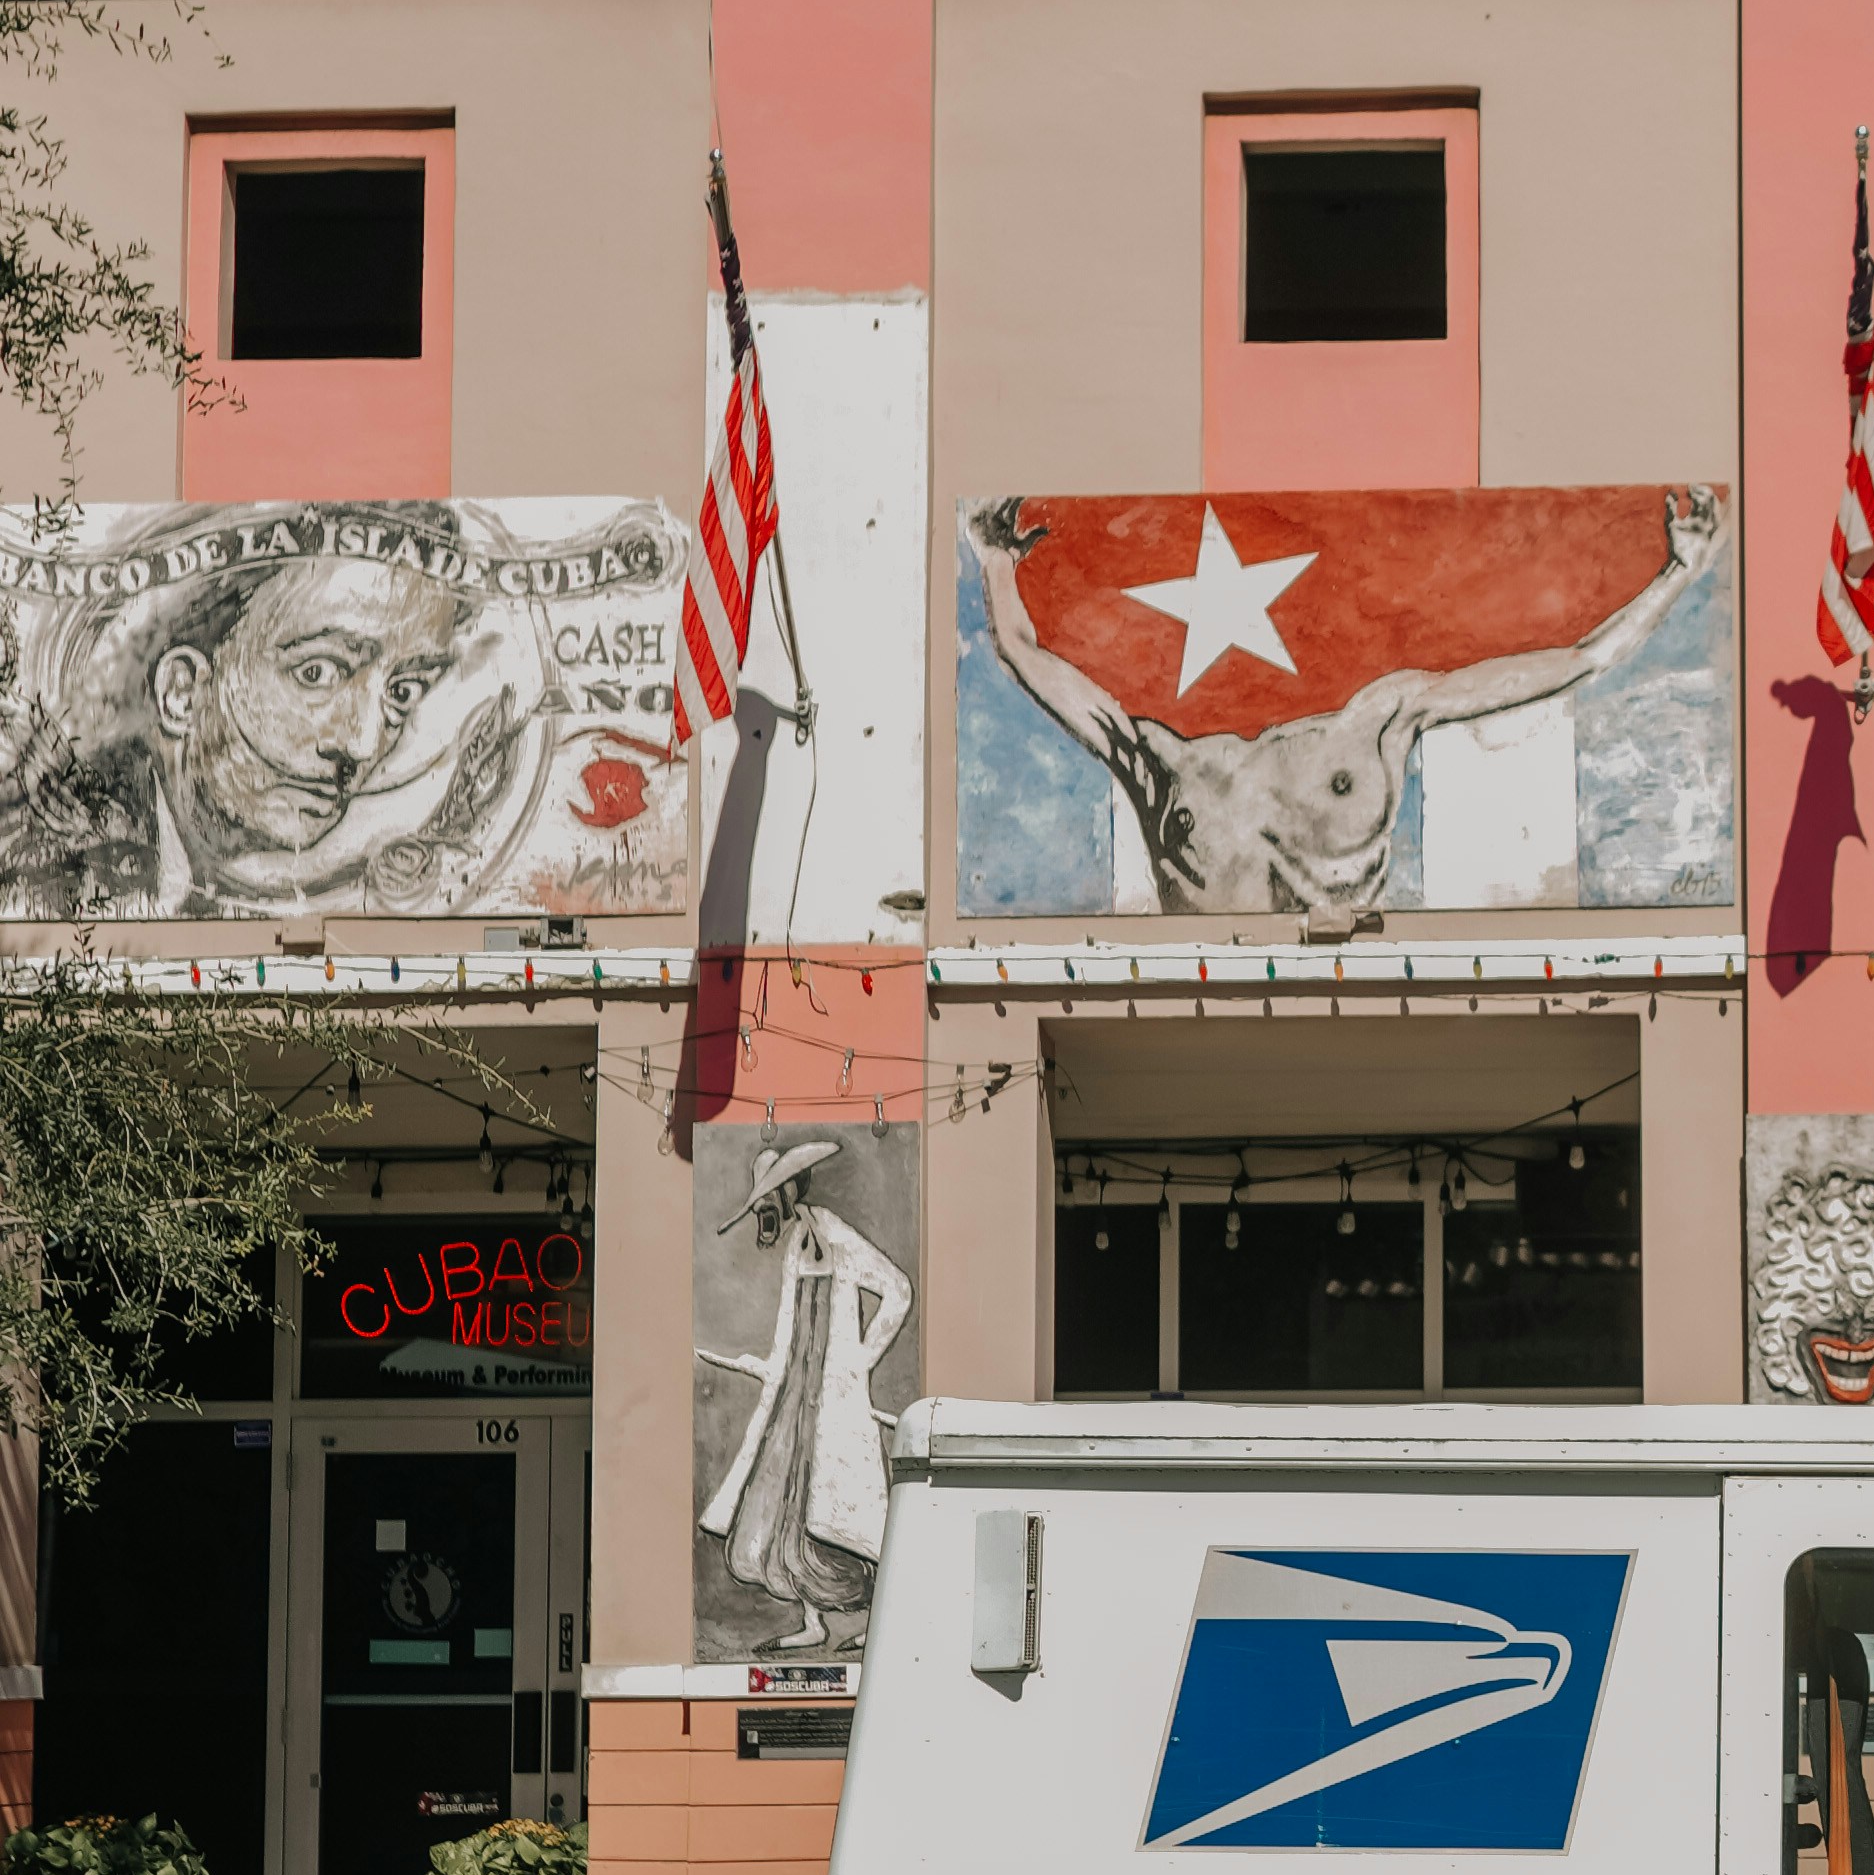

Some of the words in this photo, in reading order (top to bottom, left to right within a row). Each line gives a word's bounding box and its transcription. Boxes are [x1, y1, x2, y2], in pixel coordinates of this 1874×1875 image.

[0, 553, 150, 596] BANCO
[166, 533, 229, 580] DE
[237, 521, 300, 557] LA
[319, 520, 424, 572] ISLA
[423, 538, 491, 589] DE
[499, 546, 630, 595] CUBA
[553, 621, 667, 669] CASH
[341, 1234, 582, 1338] CUBAO
[452, 1301, 591, 1347] MUSEU
[472, 1365, 487, 1385] &
[476, 1419, 519, 1444] 106
[560, 1614, 572, 1670] PULL
